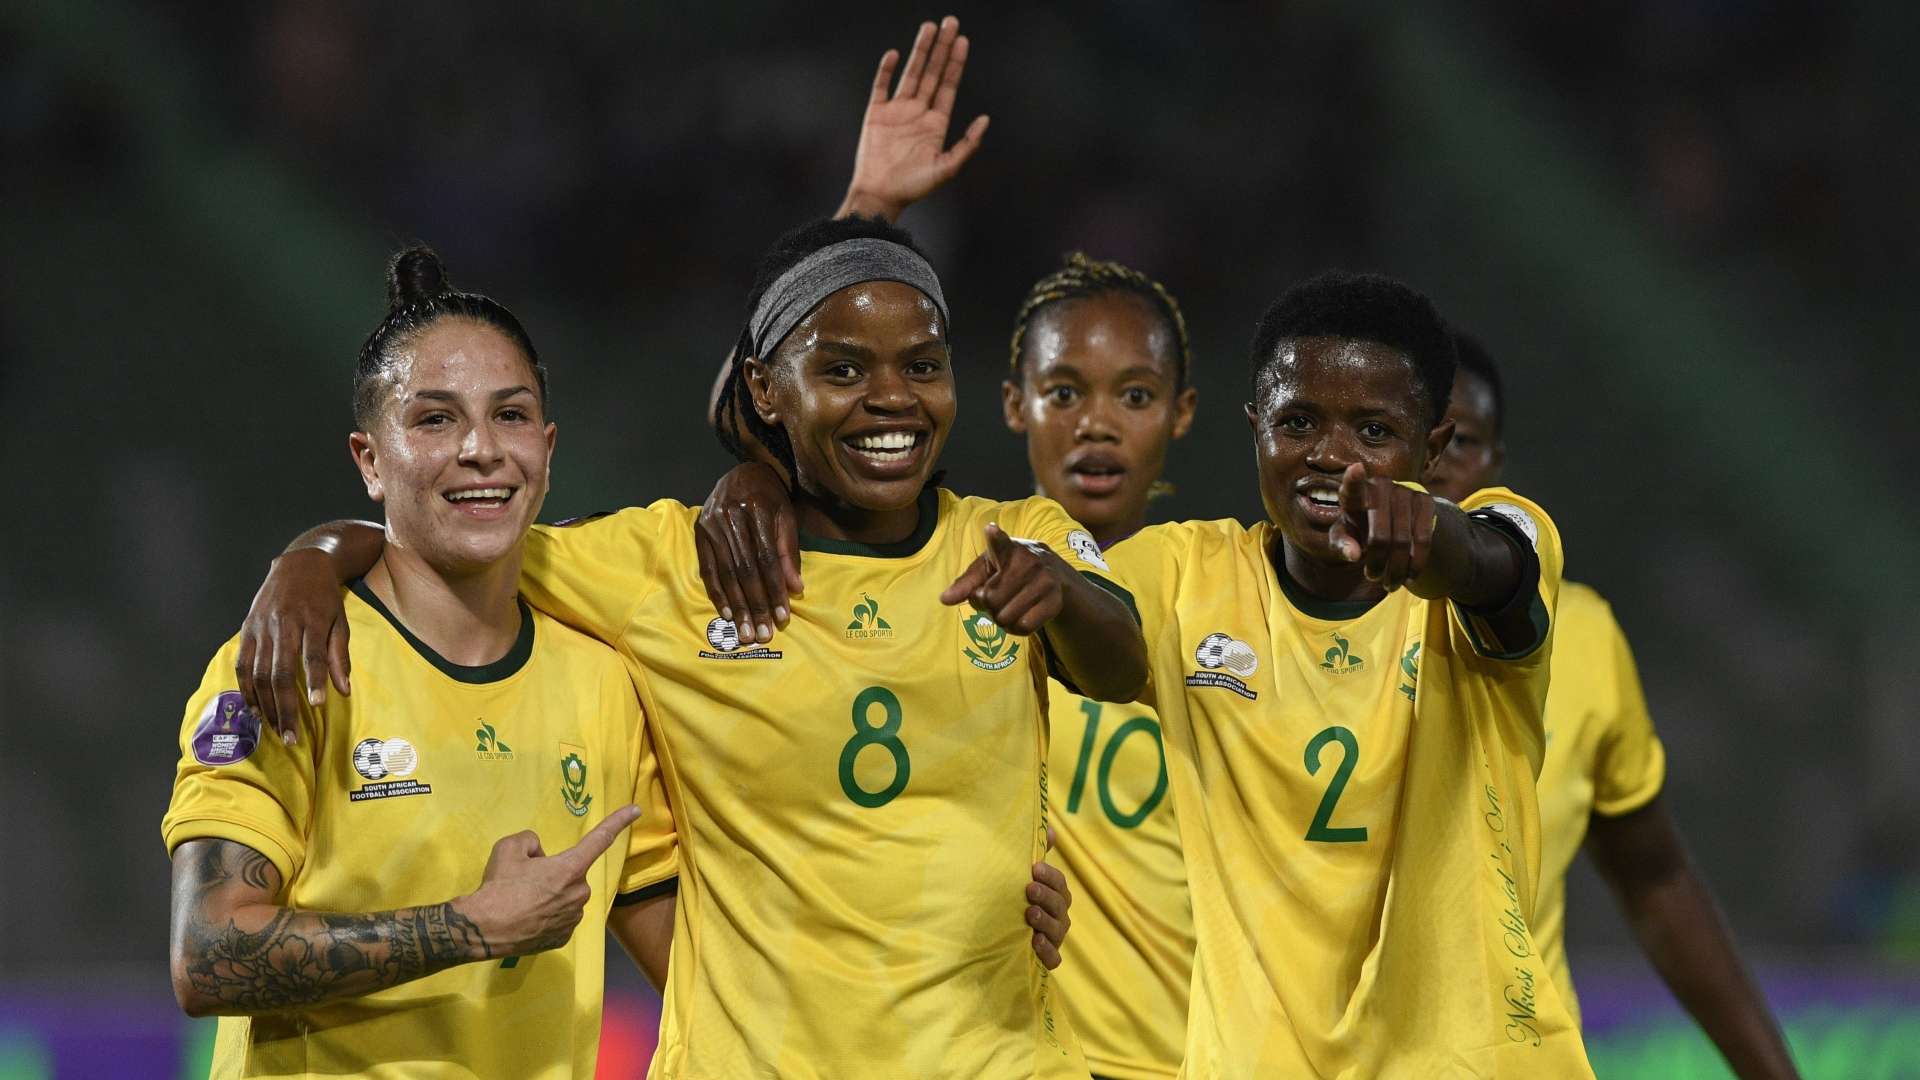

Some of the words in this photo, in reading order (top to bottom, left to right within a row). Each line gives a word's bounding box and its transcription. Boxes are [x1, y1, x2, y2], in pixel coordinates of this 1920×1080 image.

[855, 630, 868, 638] COQ
[1214, 680, 1256, 698] ASSOCIATION
[1217, 674, 1245, 689] AFRICAN
[838, 685, 911, 809] 8
[1066, 699, 1169, 830] 10
[364, 784, 388, 792] SOUTH
[388, 781, 417, 789] AFRICAN
[1303, 726, 1368, 843] 2
[351, 790, 387, 800] FOOTBALL
[387, 786, 430, 796] ASSOCIATION
